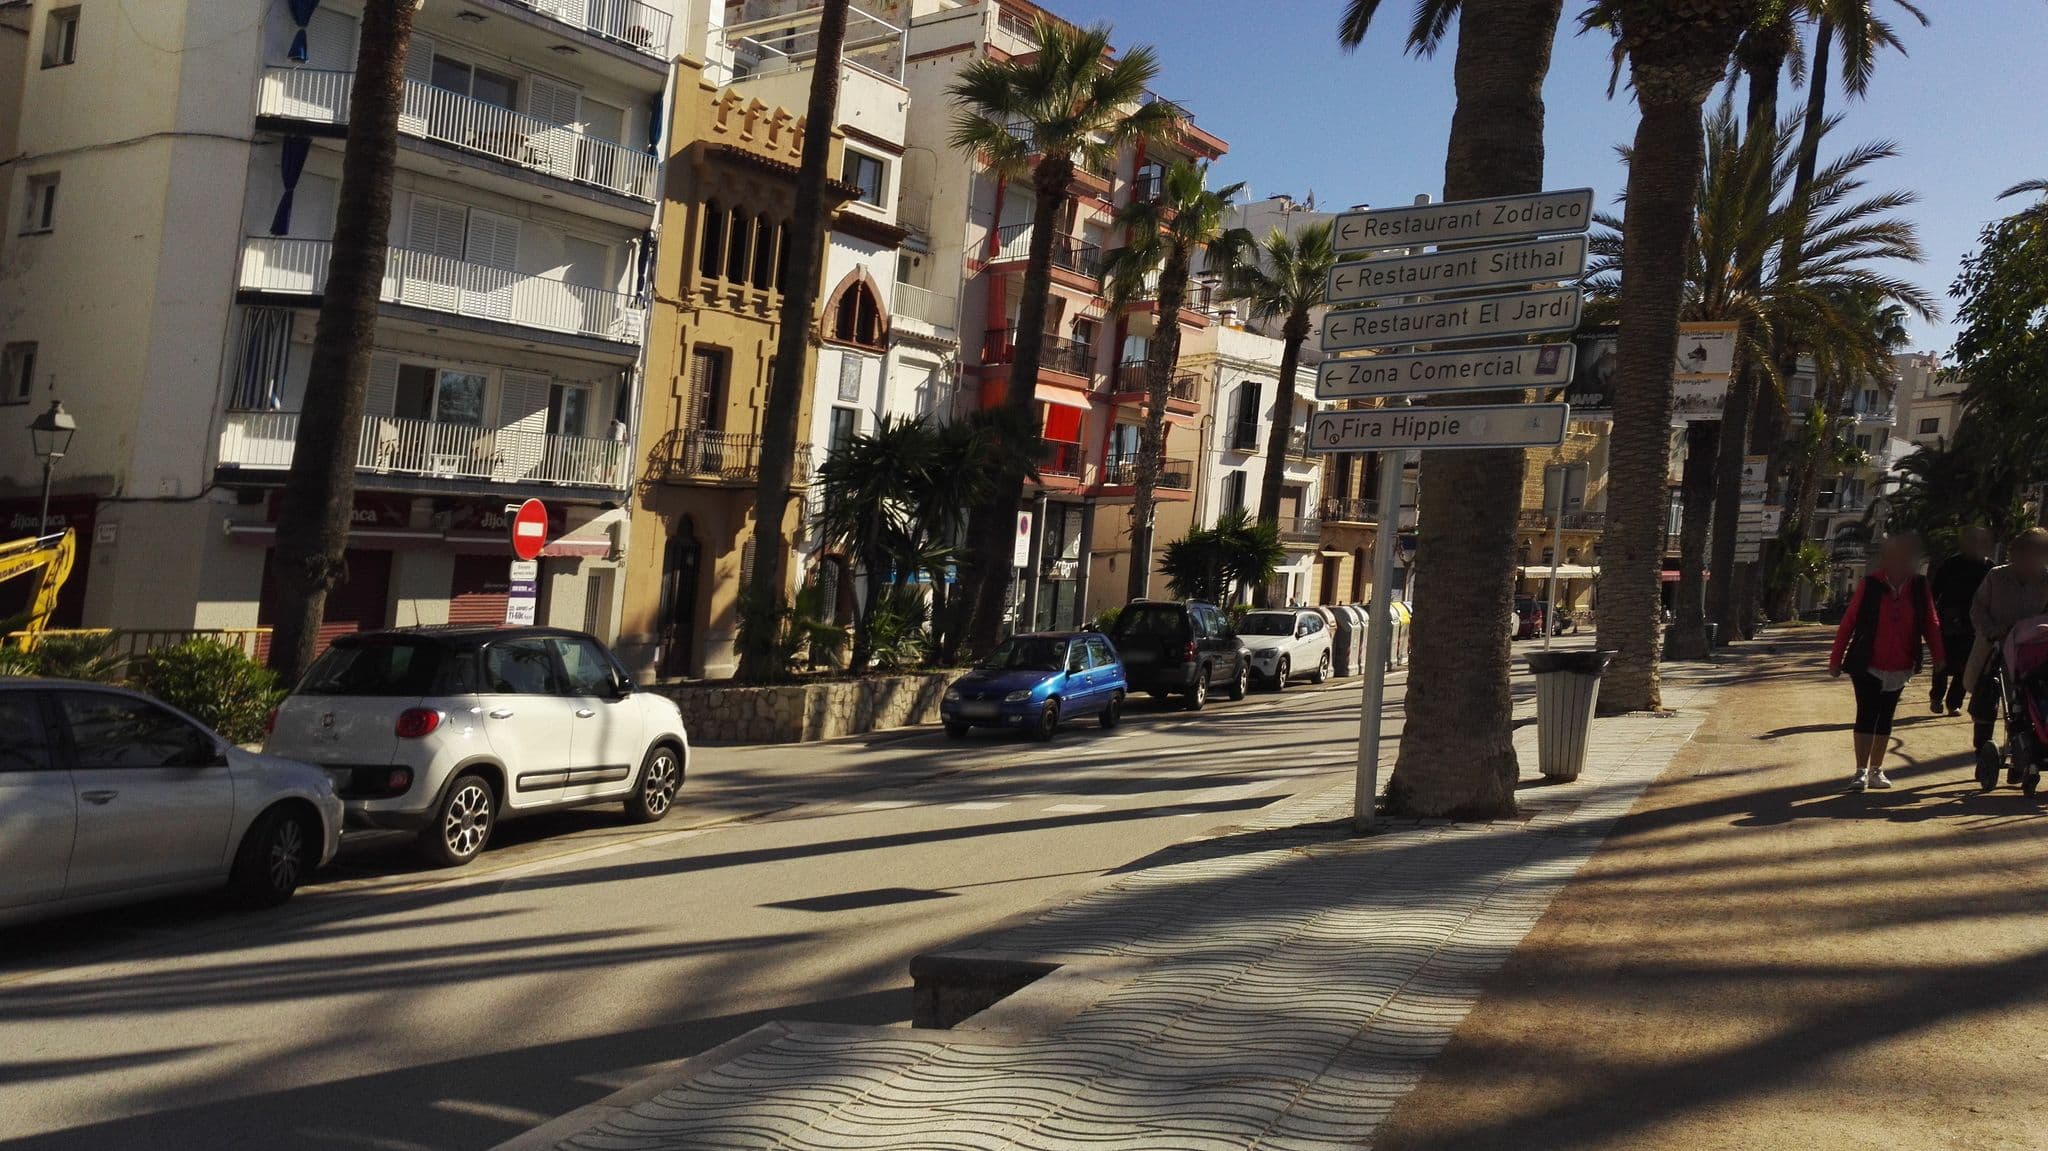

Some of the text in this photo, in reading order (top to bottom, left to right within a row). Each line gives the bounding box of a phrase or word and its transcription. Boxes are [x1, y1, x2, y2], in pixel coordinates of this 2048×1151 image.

[1364, 202, 1582, 238] Restaurant Zodiaco
[1358, 246, 1565, 288] Restaurant Sitthai
[1353, 296, 1572, 336] Restaurant El Jardí
[1348, 355, 1522, 385] Zona Comercial
[1341, 415, 1461, 441] Fira Hippie
